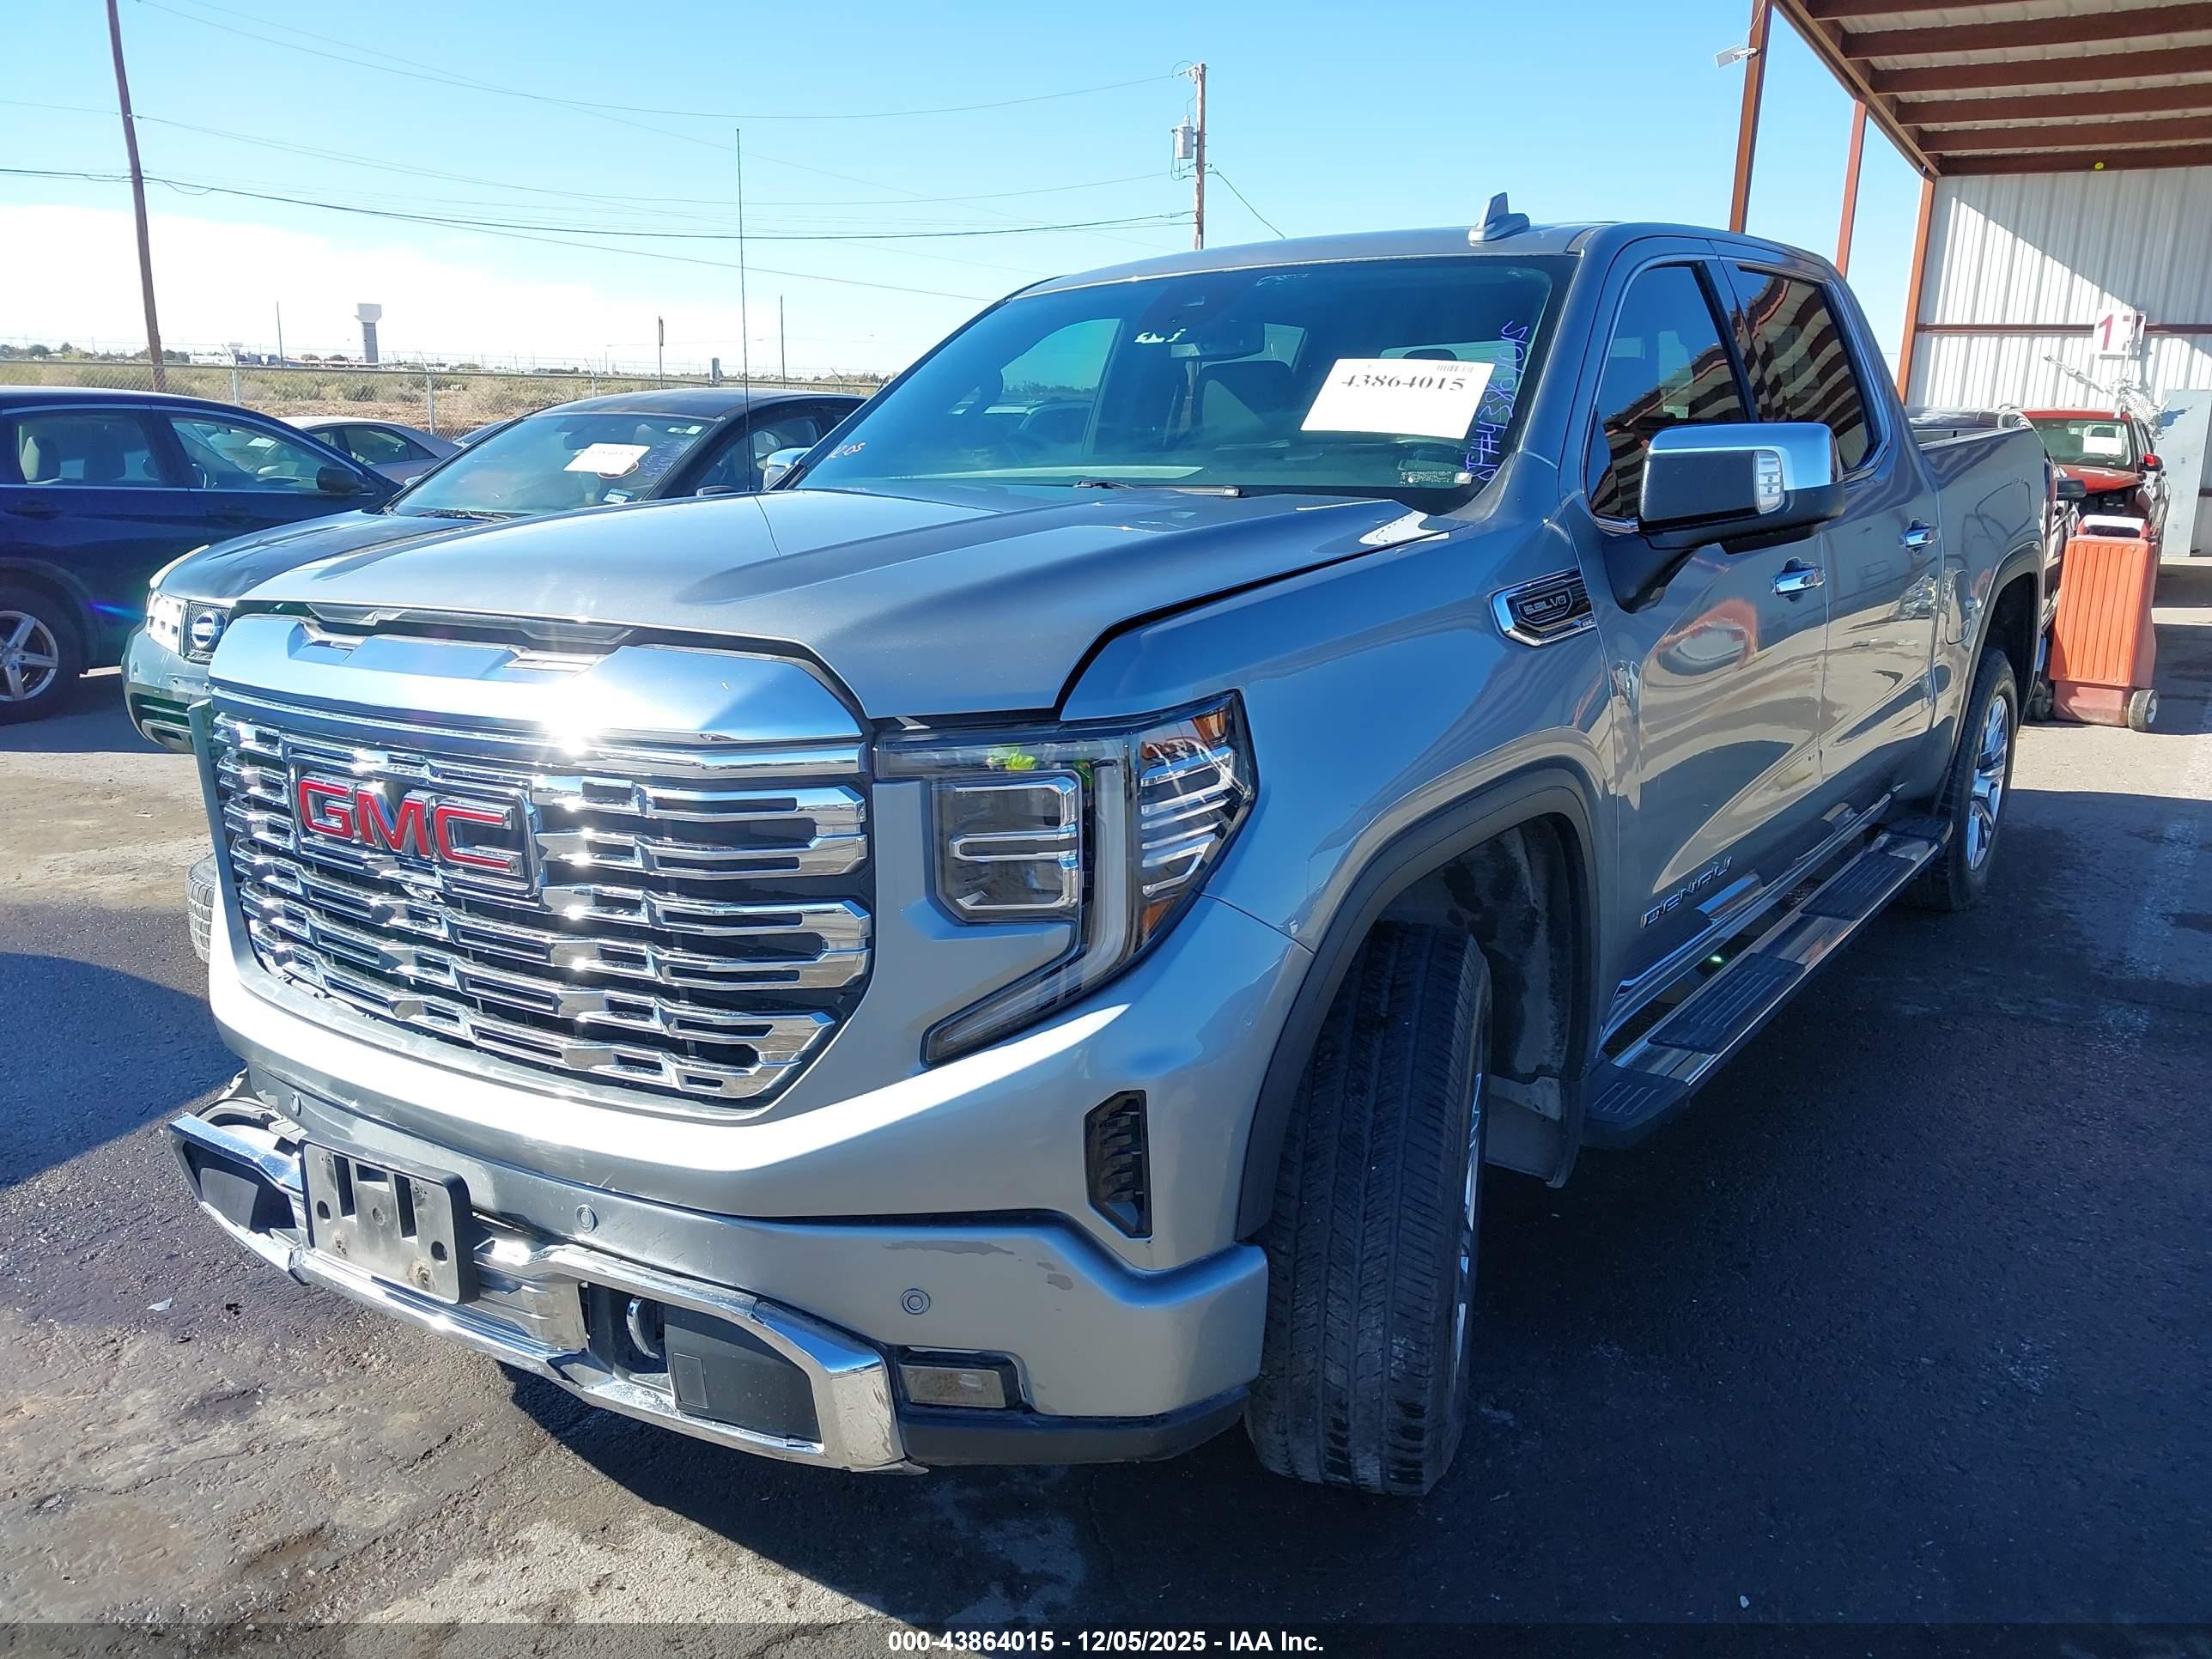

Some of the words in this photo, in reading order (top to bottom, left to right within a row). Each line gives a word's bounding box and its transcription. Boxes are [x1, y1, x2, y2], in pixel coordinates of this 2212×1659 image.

[1341, 374, 1467, 391] 43864015
[297, 770, 522, 877] GMC
[1640, 856, 1732, 929] DENALI
